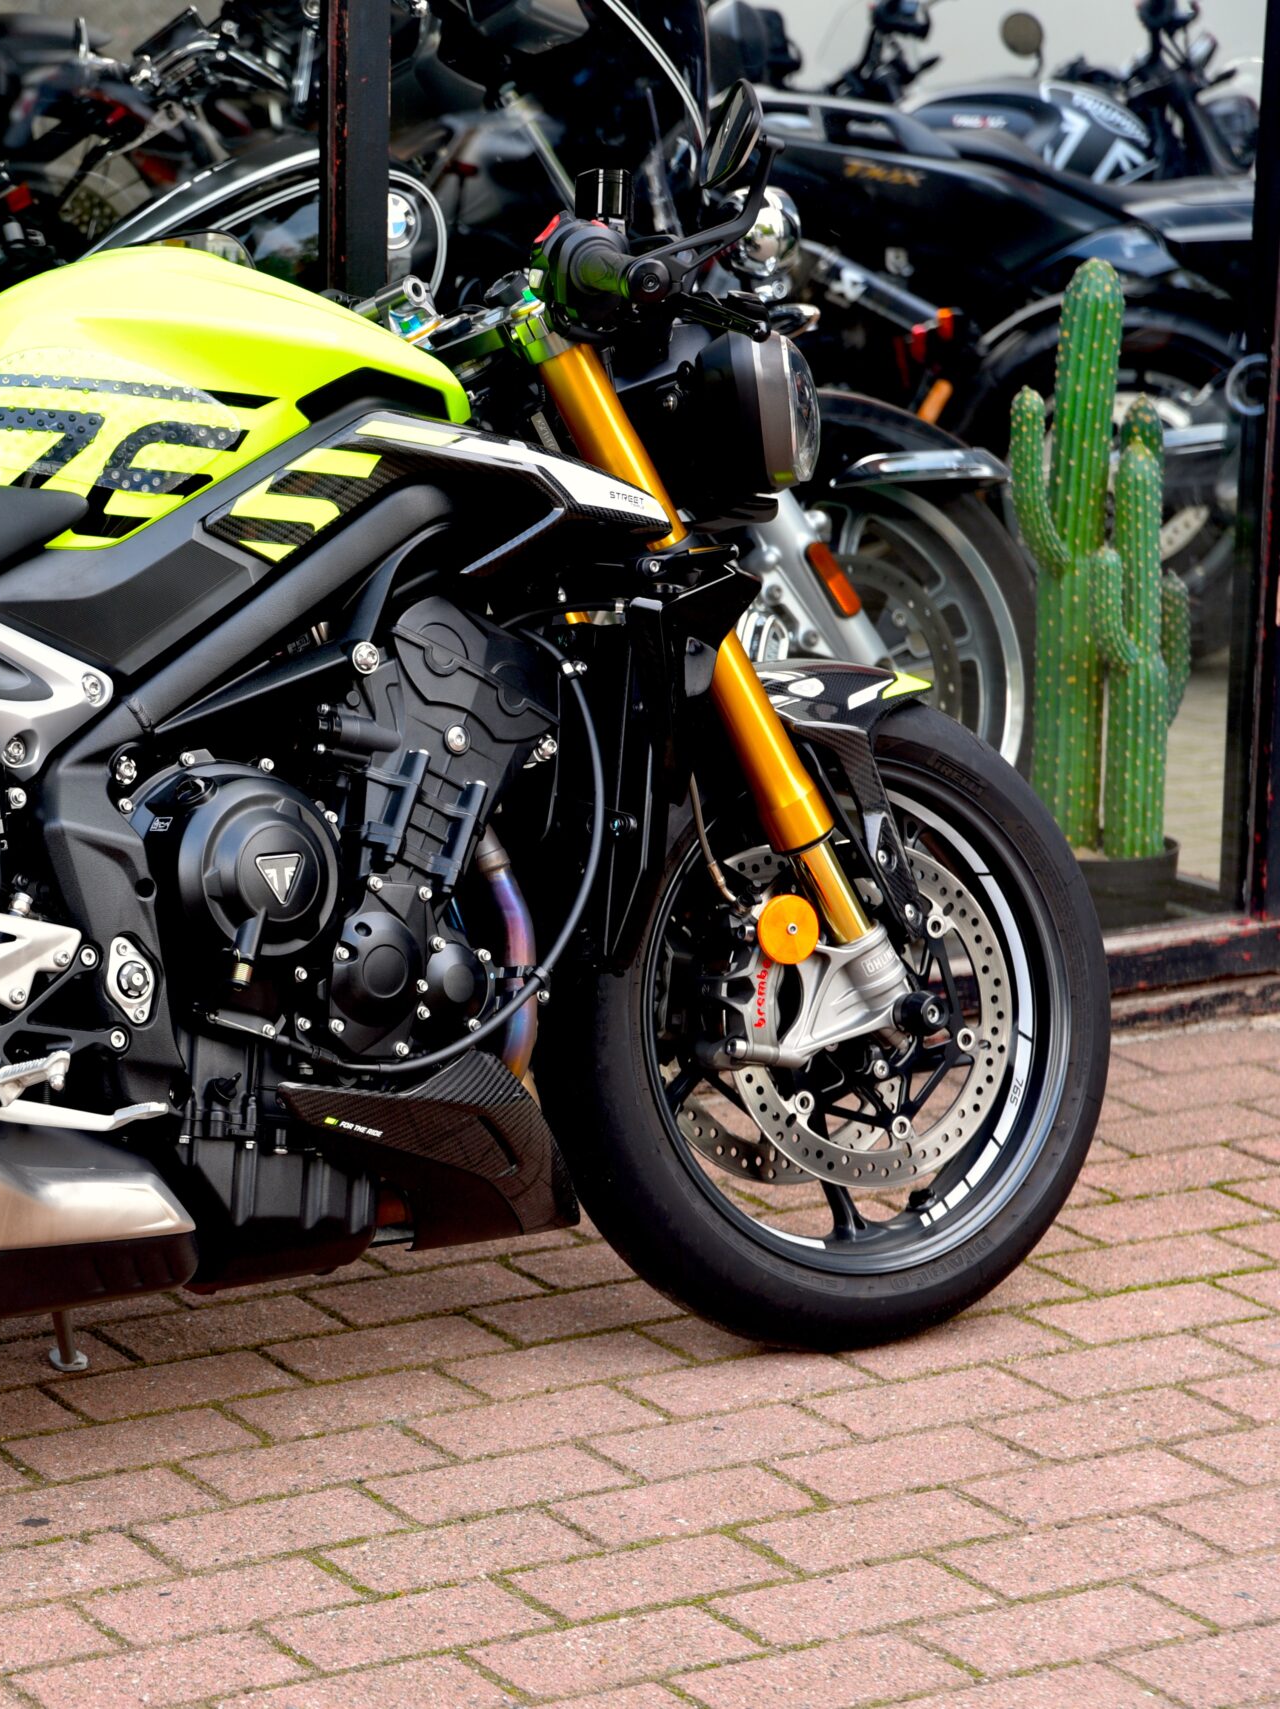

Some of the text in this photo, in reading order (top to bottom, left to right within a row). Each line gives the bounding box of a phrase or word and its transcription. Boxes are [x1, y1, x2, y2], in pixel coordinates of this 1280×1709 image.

[608, 490, 645, 505] STREET
[753, 958, 772, 1029] brembo
[339, 1120, 384, 1138] FOR THE RIDE
